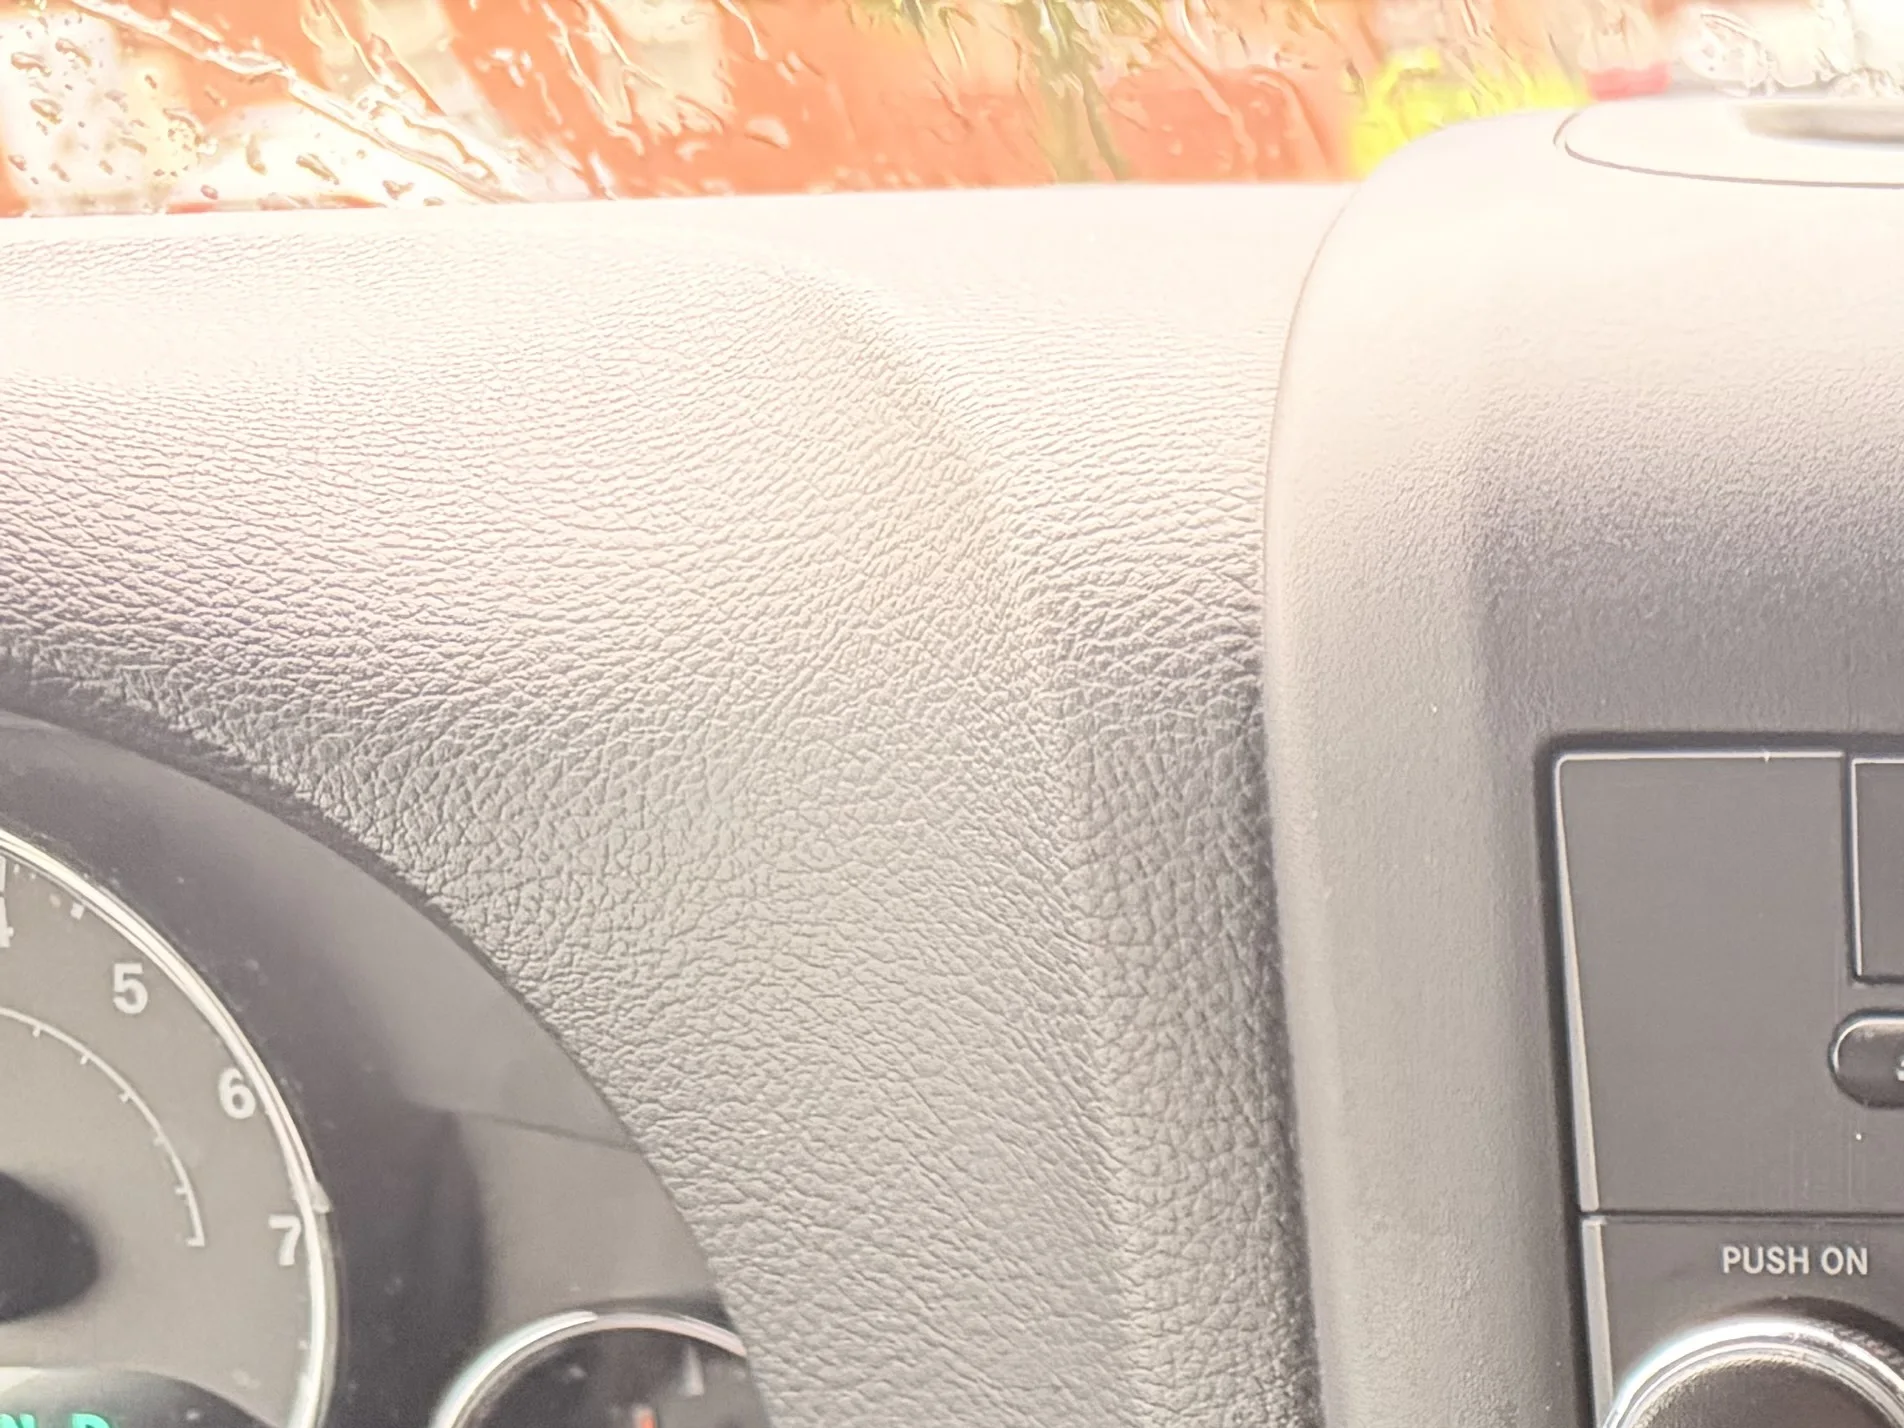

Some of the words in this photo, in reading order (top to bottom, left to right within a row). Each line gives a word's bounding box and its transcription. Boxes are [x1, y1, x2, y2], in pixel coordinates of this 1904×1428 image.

[112, 962, 149, 1015] 5
[217, 1067, 257, 1120] 6
[267, 1213, 304, 1267] 7
[1722, 1245, 1810, 1274] PUSH
[1820, 1246, 1868, 1275] ON
